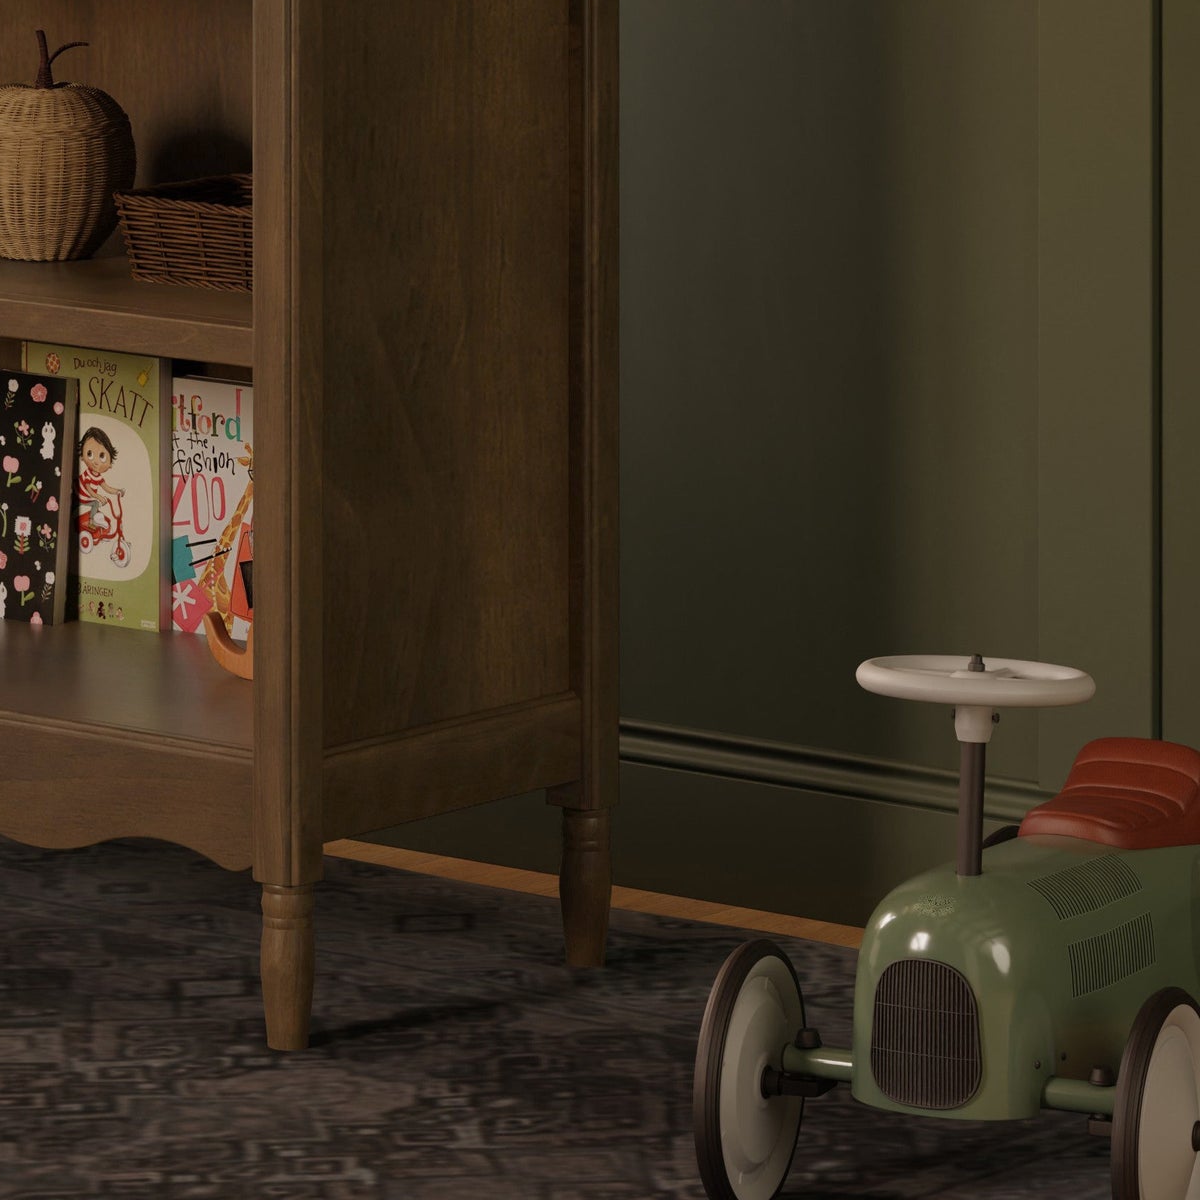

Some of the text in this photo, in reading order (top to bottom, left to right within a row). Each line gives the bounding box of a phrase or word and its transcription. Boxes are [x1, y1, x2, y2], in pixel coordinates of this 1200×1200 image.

[73, 357, 118, 377] Du och jag
[87, 376, 154, 428] SKATT
[187, 432, 208, 449] the
[173, 445, 236, 484] fashion
[171, 473, 226, 535] ZOO
